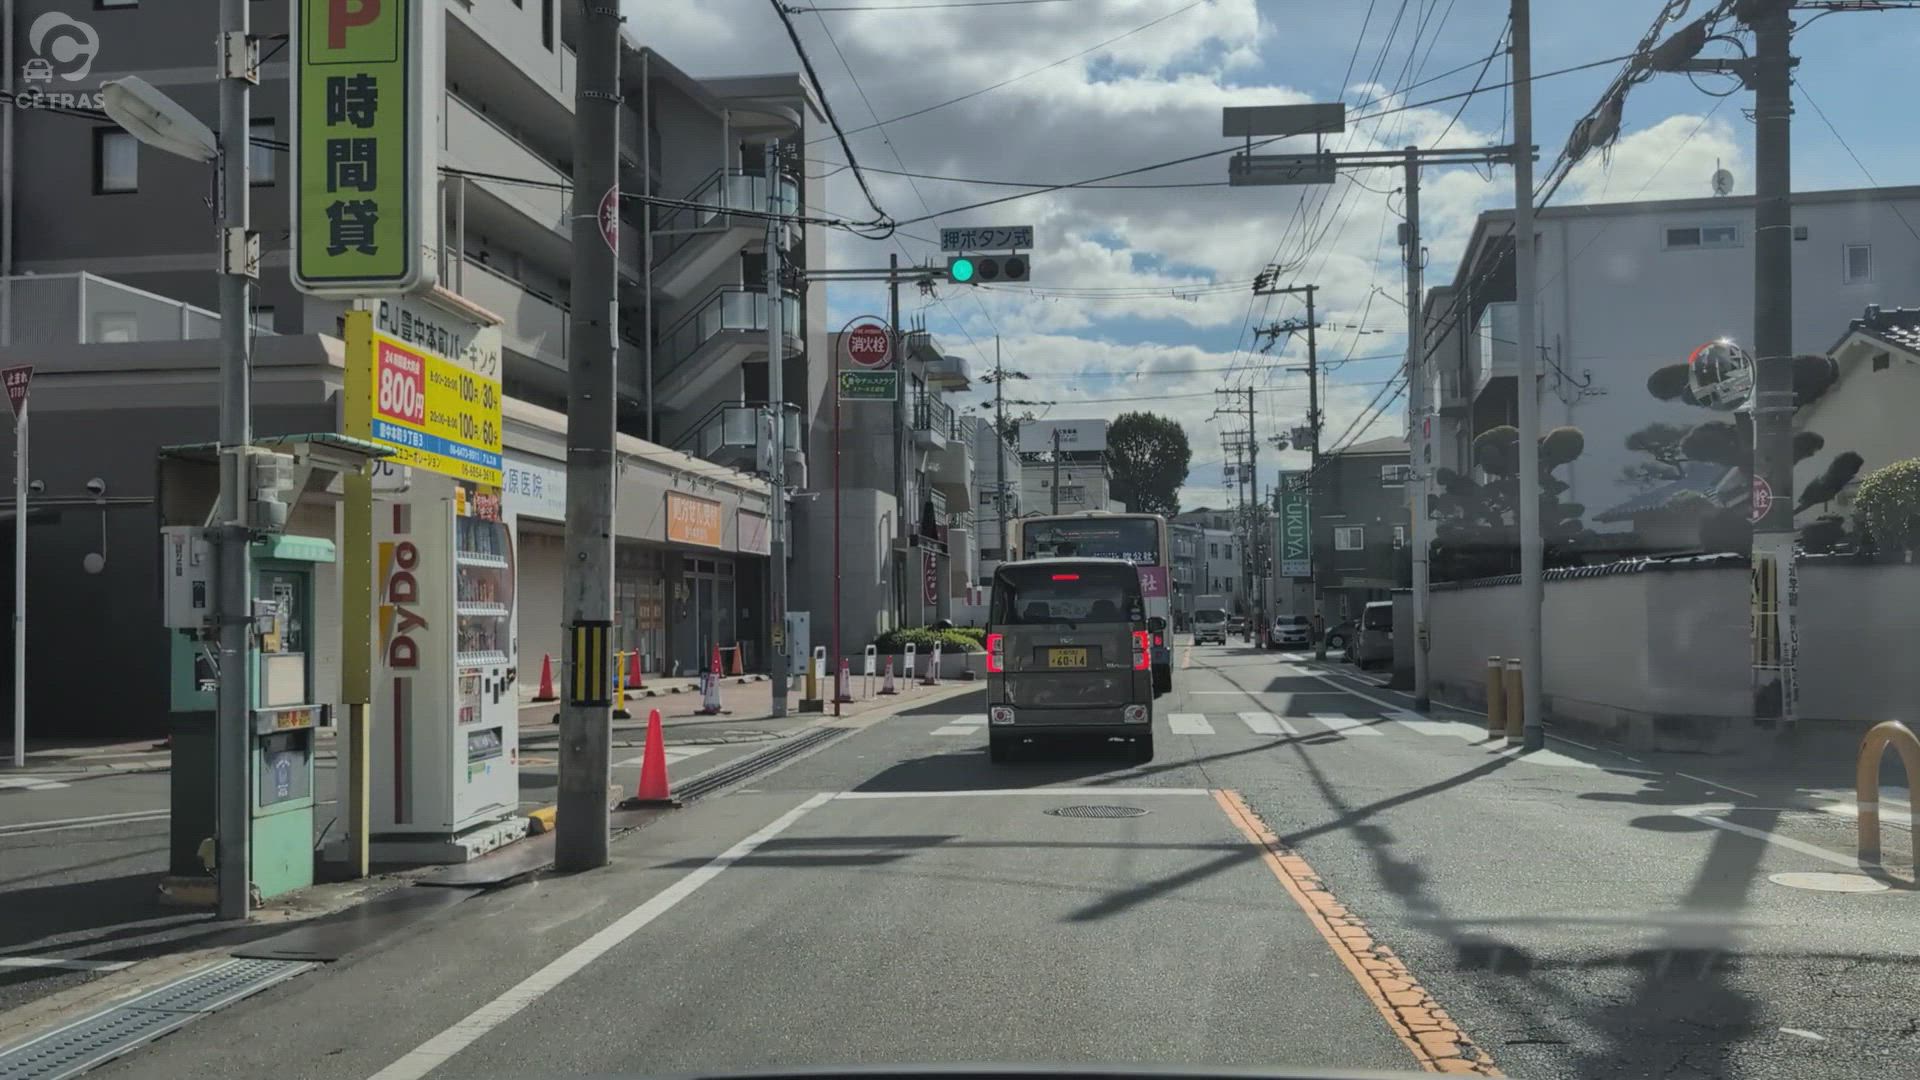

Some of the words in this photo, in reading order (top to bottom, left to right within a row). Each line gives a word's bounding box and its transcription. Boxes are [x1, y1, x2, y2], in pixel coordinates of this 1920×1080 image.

[325, 73, 379, 257] 時間貸
[943, 228, 1031, 249] 押ボタン式
[851, 336, 886, 353] 消火栓
[7, 371, 28, 386] 止まれ
[380, 367, 425, 420] 800円
[389, 541, 429, 668] DyDo
